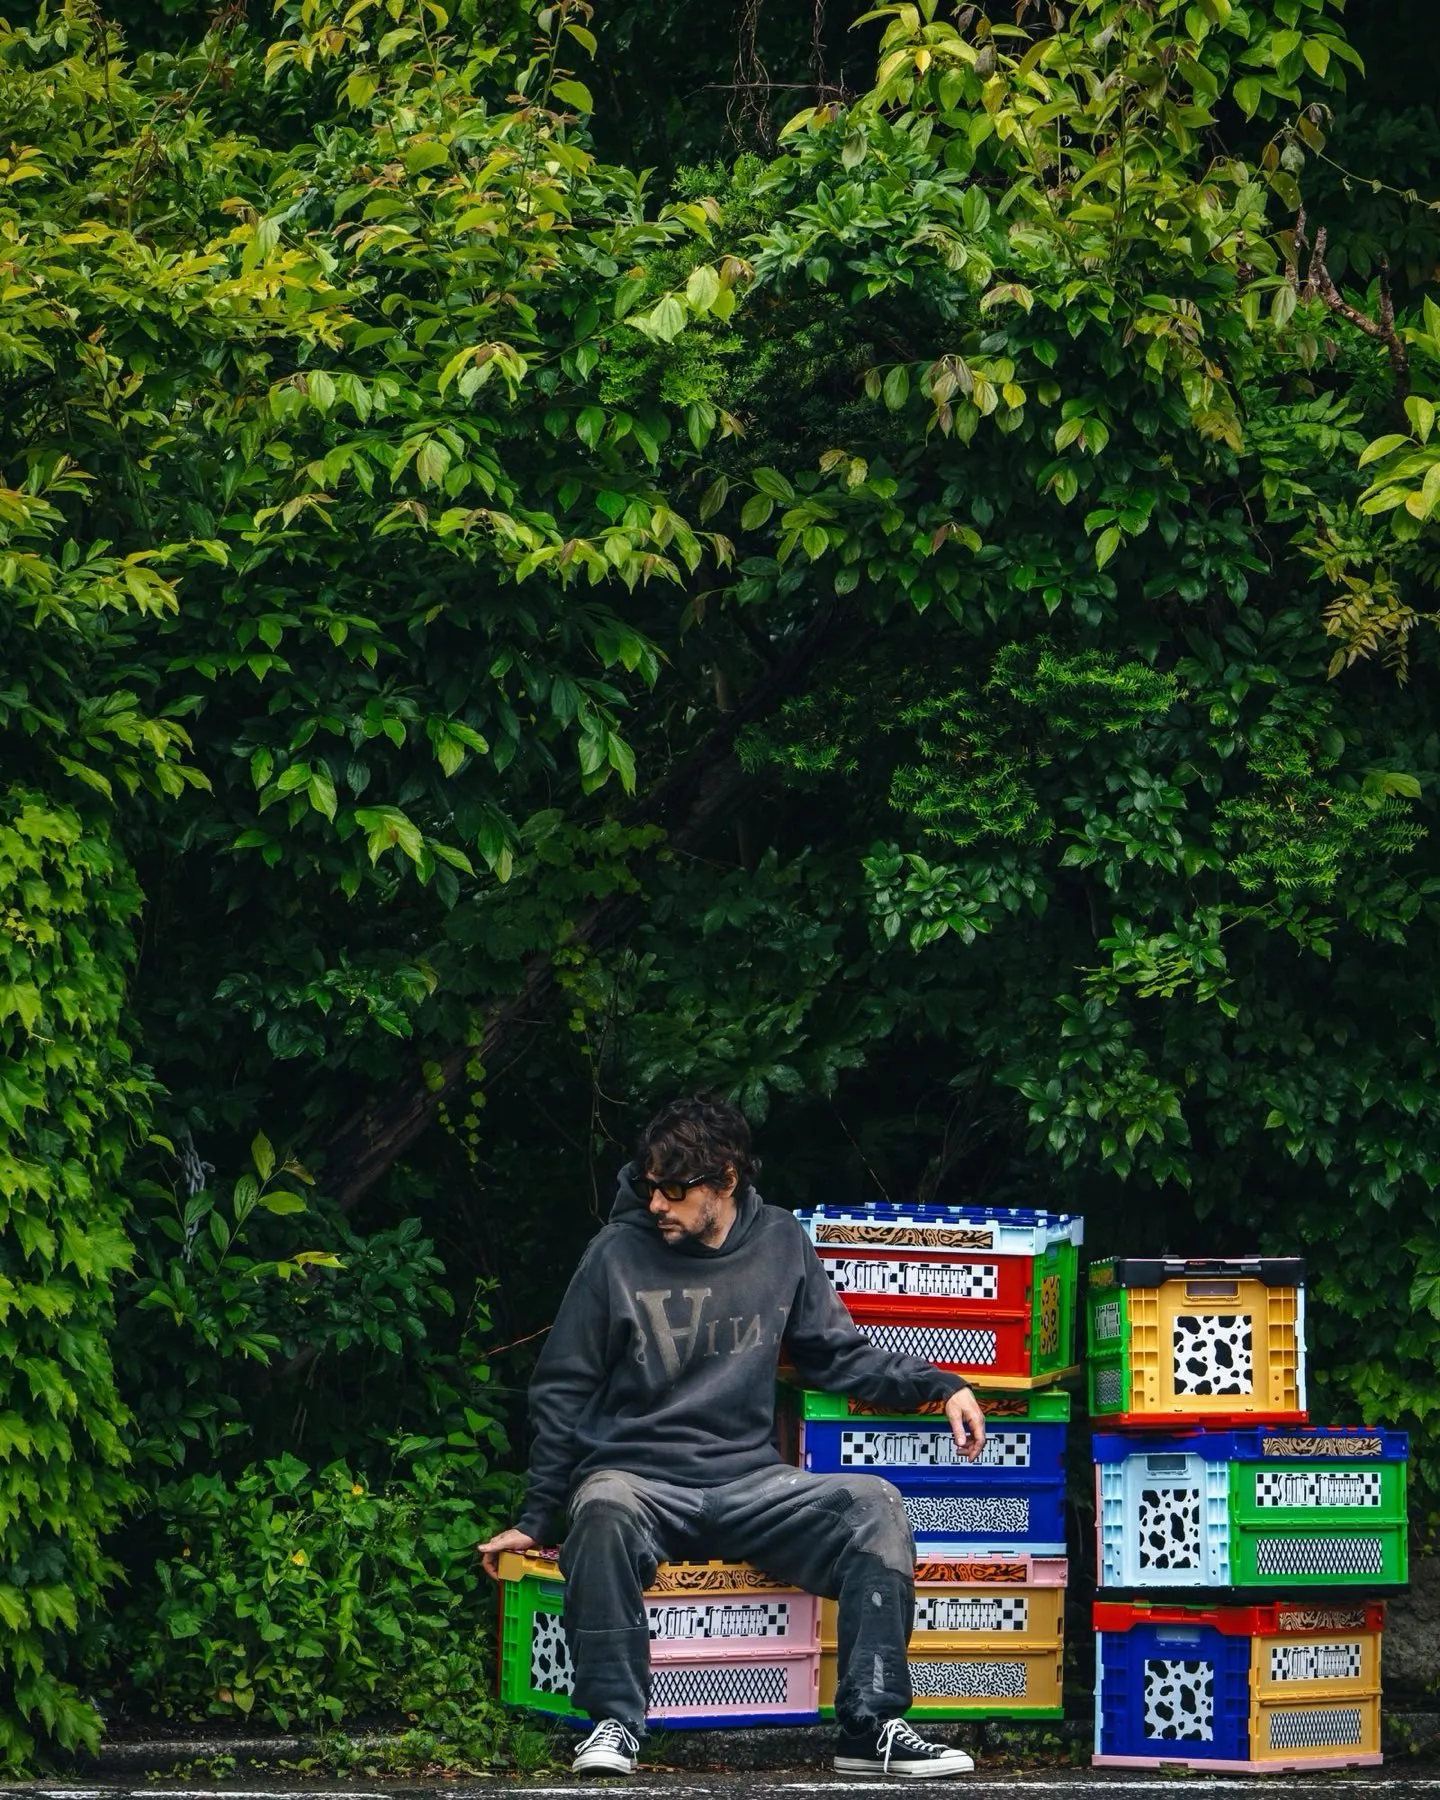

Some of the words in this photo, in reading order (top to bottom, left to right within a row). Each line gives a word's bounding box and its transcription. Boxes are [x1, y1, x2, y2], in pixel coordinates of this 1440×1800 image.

[844, 1262, 891, 1291] SAINT
[873, 1434, 922, 1464] SAINT
[1277, 1475, 1310, 1504] SAINT
[655, 1608, 698, 1639] SAINT
